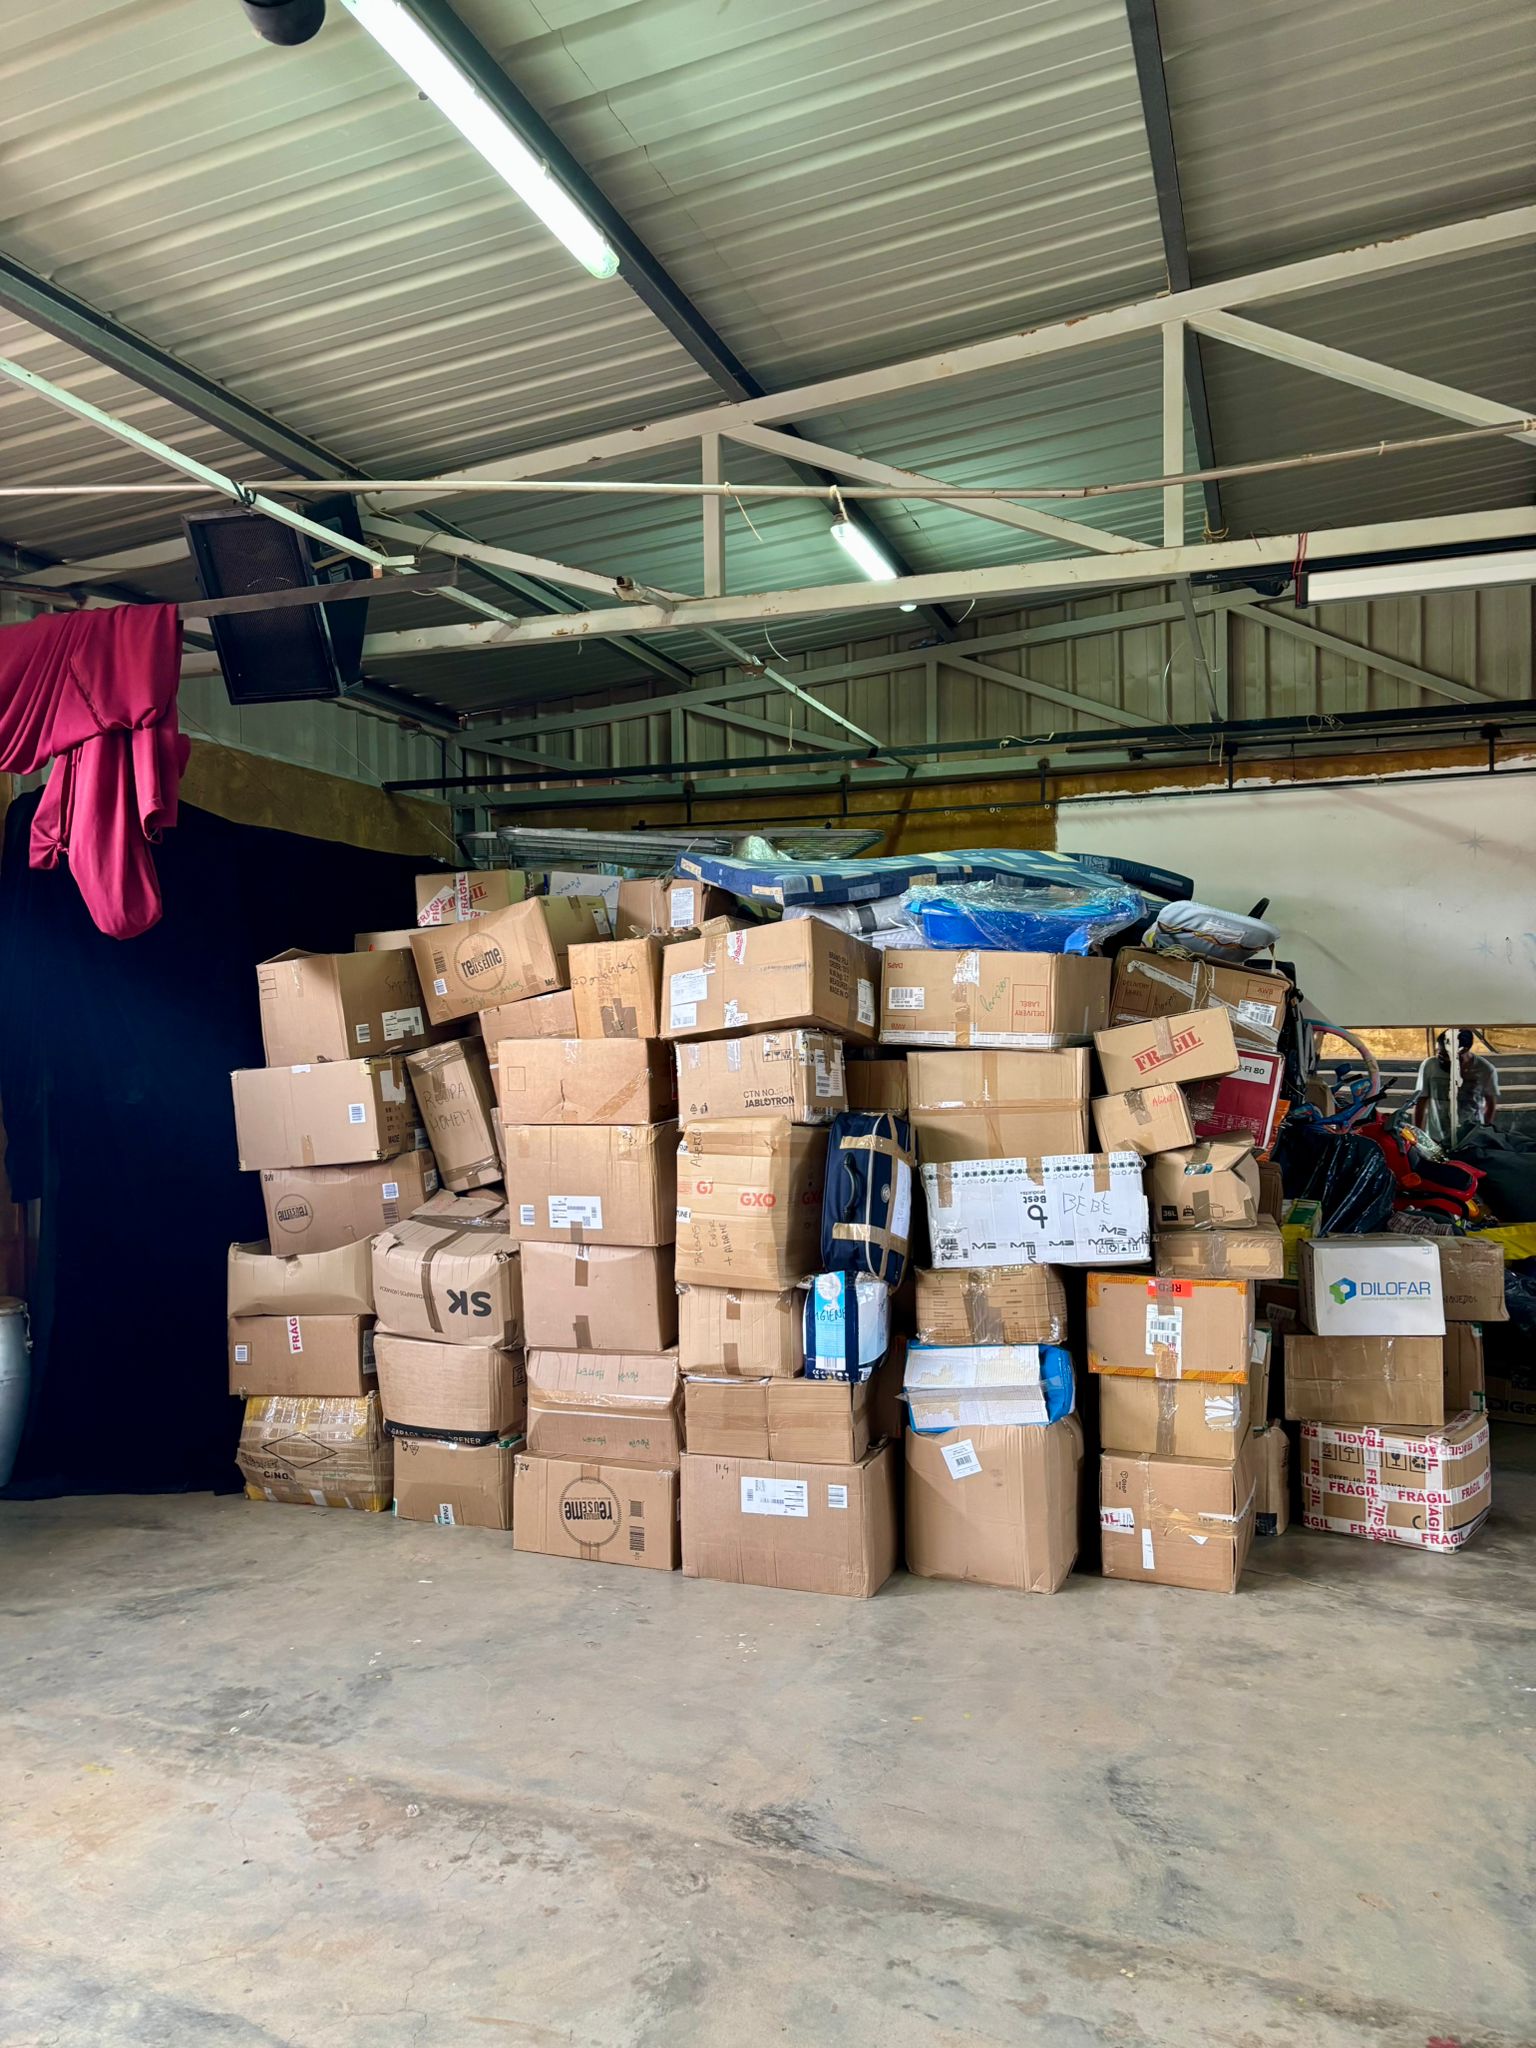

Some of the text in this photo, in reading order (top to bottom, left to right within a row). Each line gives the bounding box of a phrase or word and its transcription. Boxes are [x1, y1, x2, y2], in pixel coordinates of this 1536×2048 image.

[1134, 1030, 1201, 1071] FRGIL
[1253, 1067, 1265, 1075] 80
[743, 1090, 761, 1099] CTN
[745, 1095, 795, 1108] JABLOTRON
[740, 1192, 777, 1207] GXO
[1023, 1195, 1047, 1204] Best
[1360, 1281, 1431, 1296] DILOFAR
[446, 1288, 492, 1317] SK
[1329, 1480, 1379, 1498] FRÁGIL
[1397, 1486, 1452, 1504] FRÁGIL
[1421, 1531, 1466, 1546] FRÁGIL
